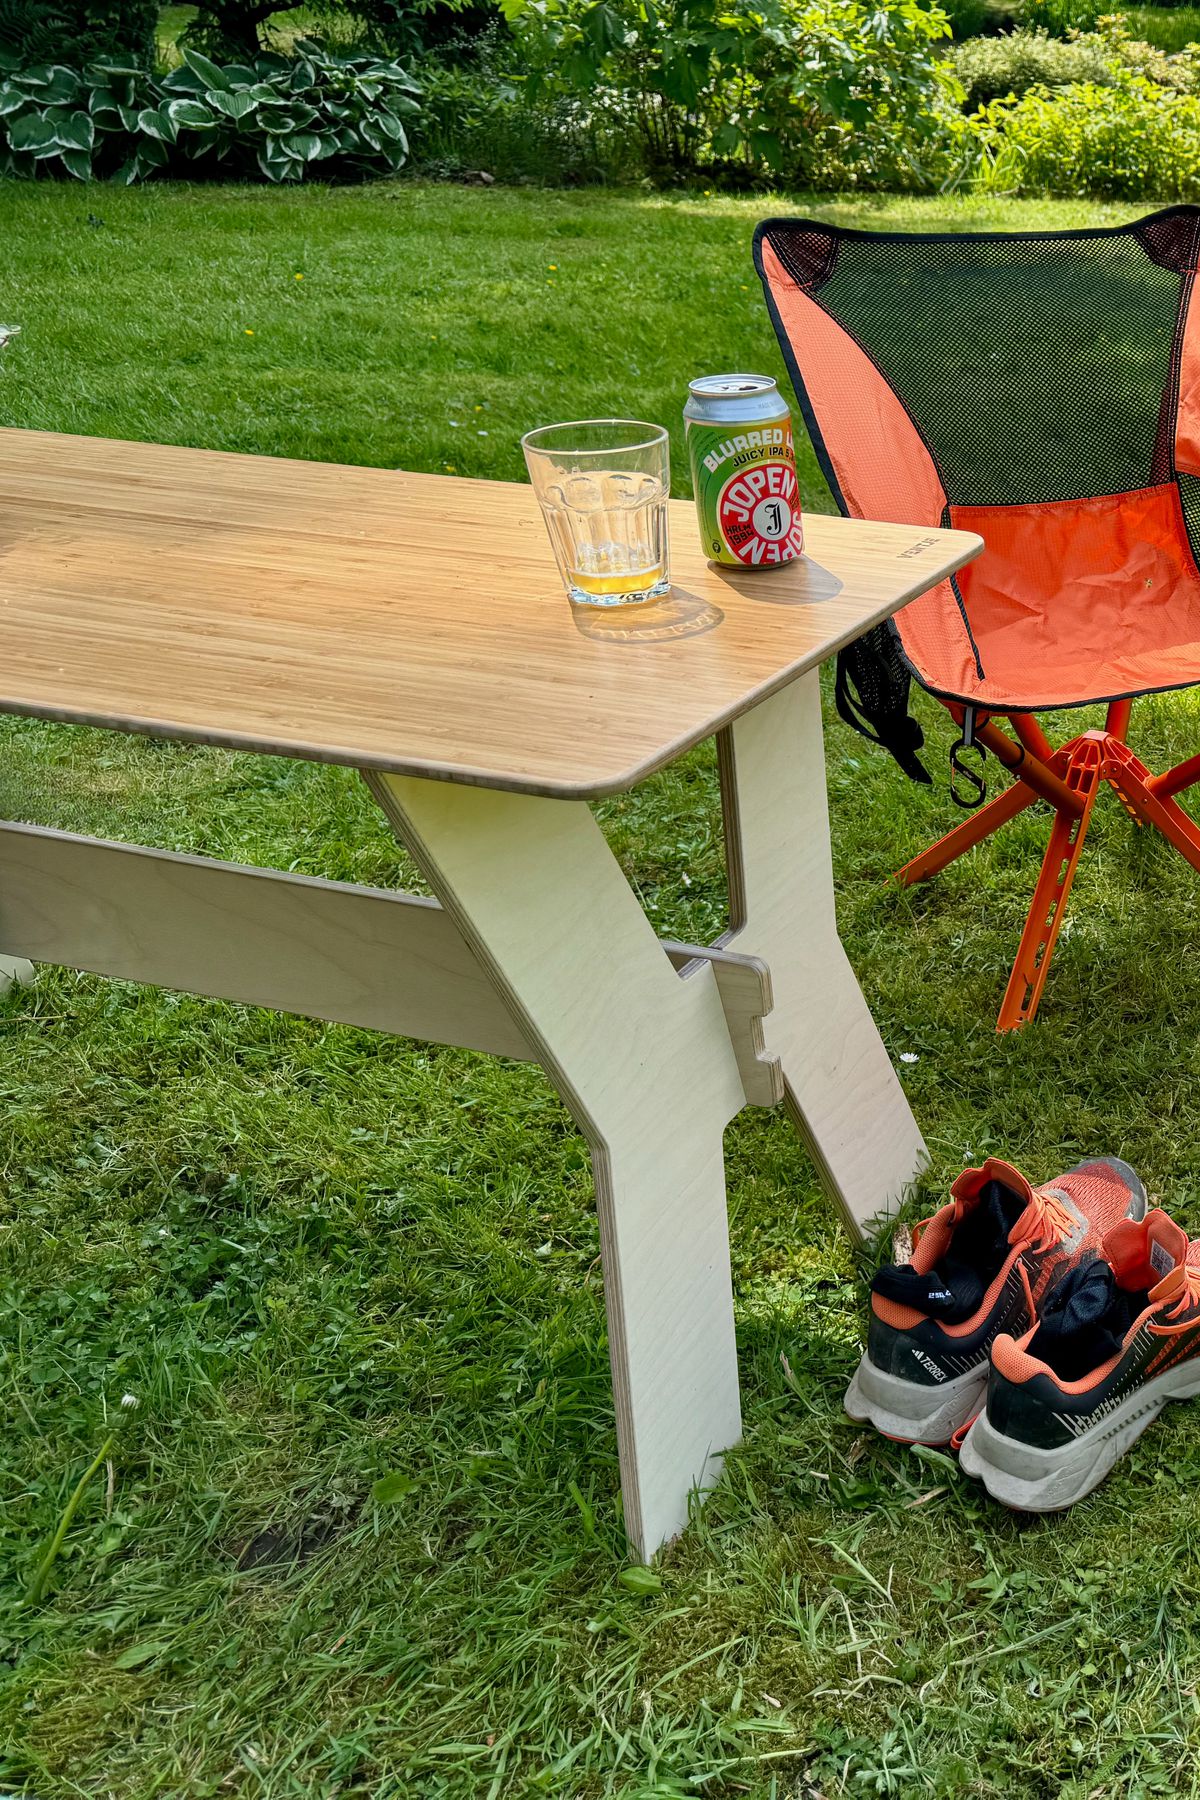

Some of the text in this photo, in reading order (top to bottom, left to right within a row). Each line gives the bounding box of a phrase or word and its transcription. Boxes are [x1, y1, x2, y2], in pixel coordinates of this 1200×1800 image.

[703, 429, 783, 473] BLURRED
[732, 447, 765, 467] JUICY
[769, 446, 784, 456] IPA
[723, 467, 796, 523] JOPEN
[725, 524, 752, 536] HRLM
[728, 530, 755, 546] 1994
[920, 1356, 949, 1383] TERREX
